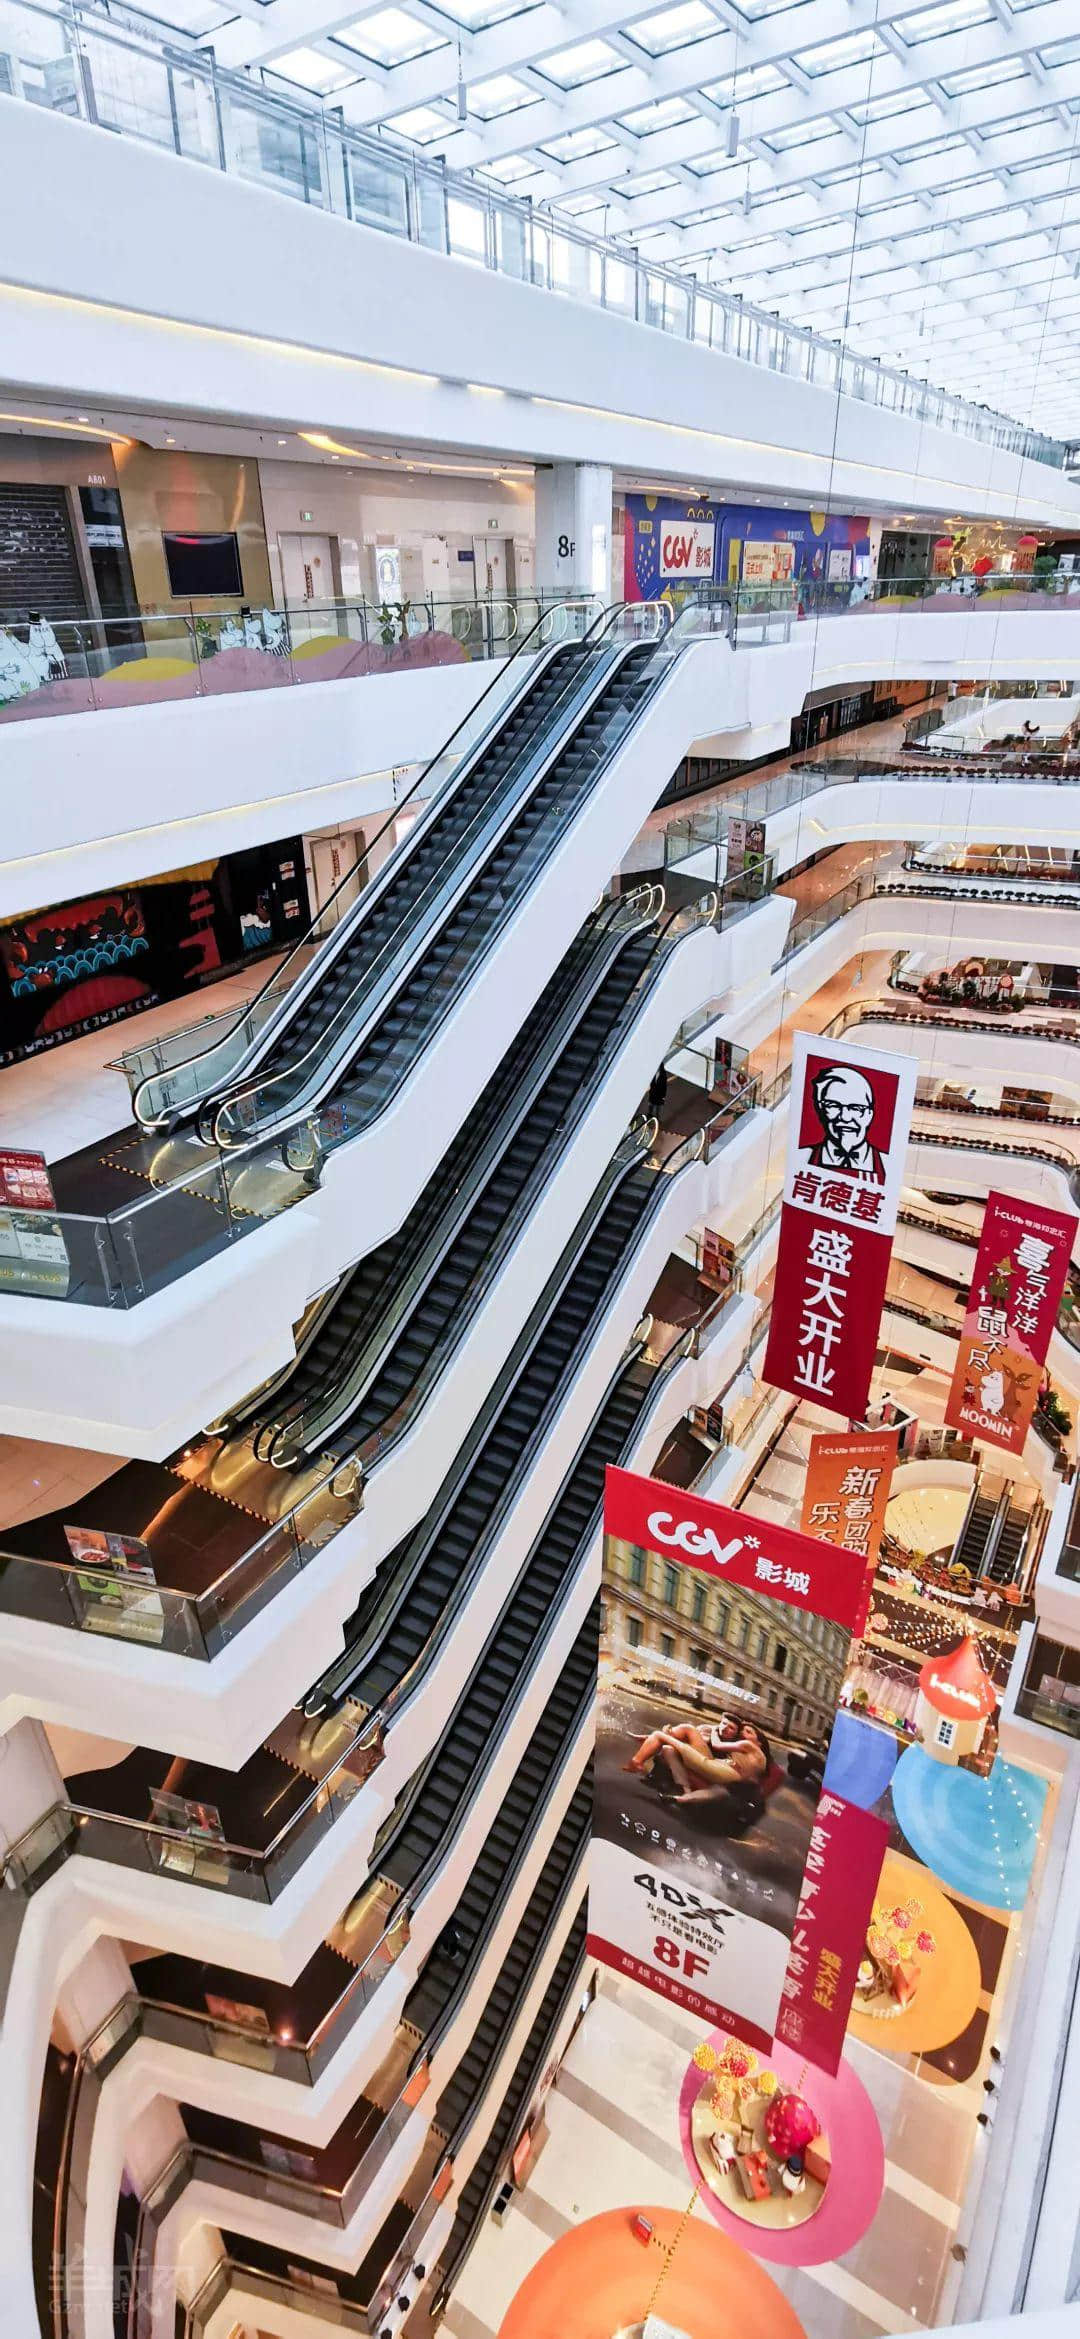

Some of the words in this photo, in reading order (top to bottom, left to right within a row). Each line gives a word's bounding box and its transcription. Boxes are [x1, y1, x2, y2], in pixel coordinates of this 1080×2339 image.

[558, 534, 576, 558] 8F
[663, 534, 694, 569] CGV
[792, 1171, 886, 1224] 肯德基
[1012, 1232, 1055, 1336] 喜气洋洋
[793, 1228, 854, 1396] 盛大开业
[959, 1407, 1014, 1439] MOOMIN
[647, 1511, 743, 1564] CGV
[755, 1556, 811, 1595] 影城
[634, 1873, 735, 1935] 4DX
[652, 1935, 710, 1979] 8F
